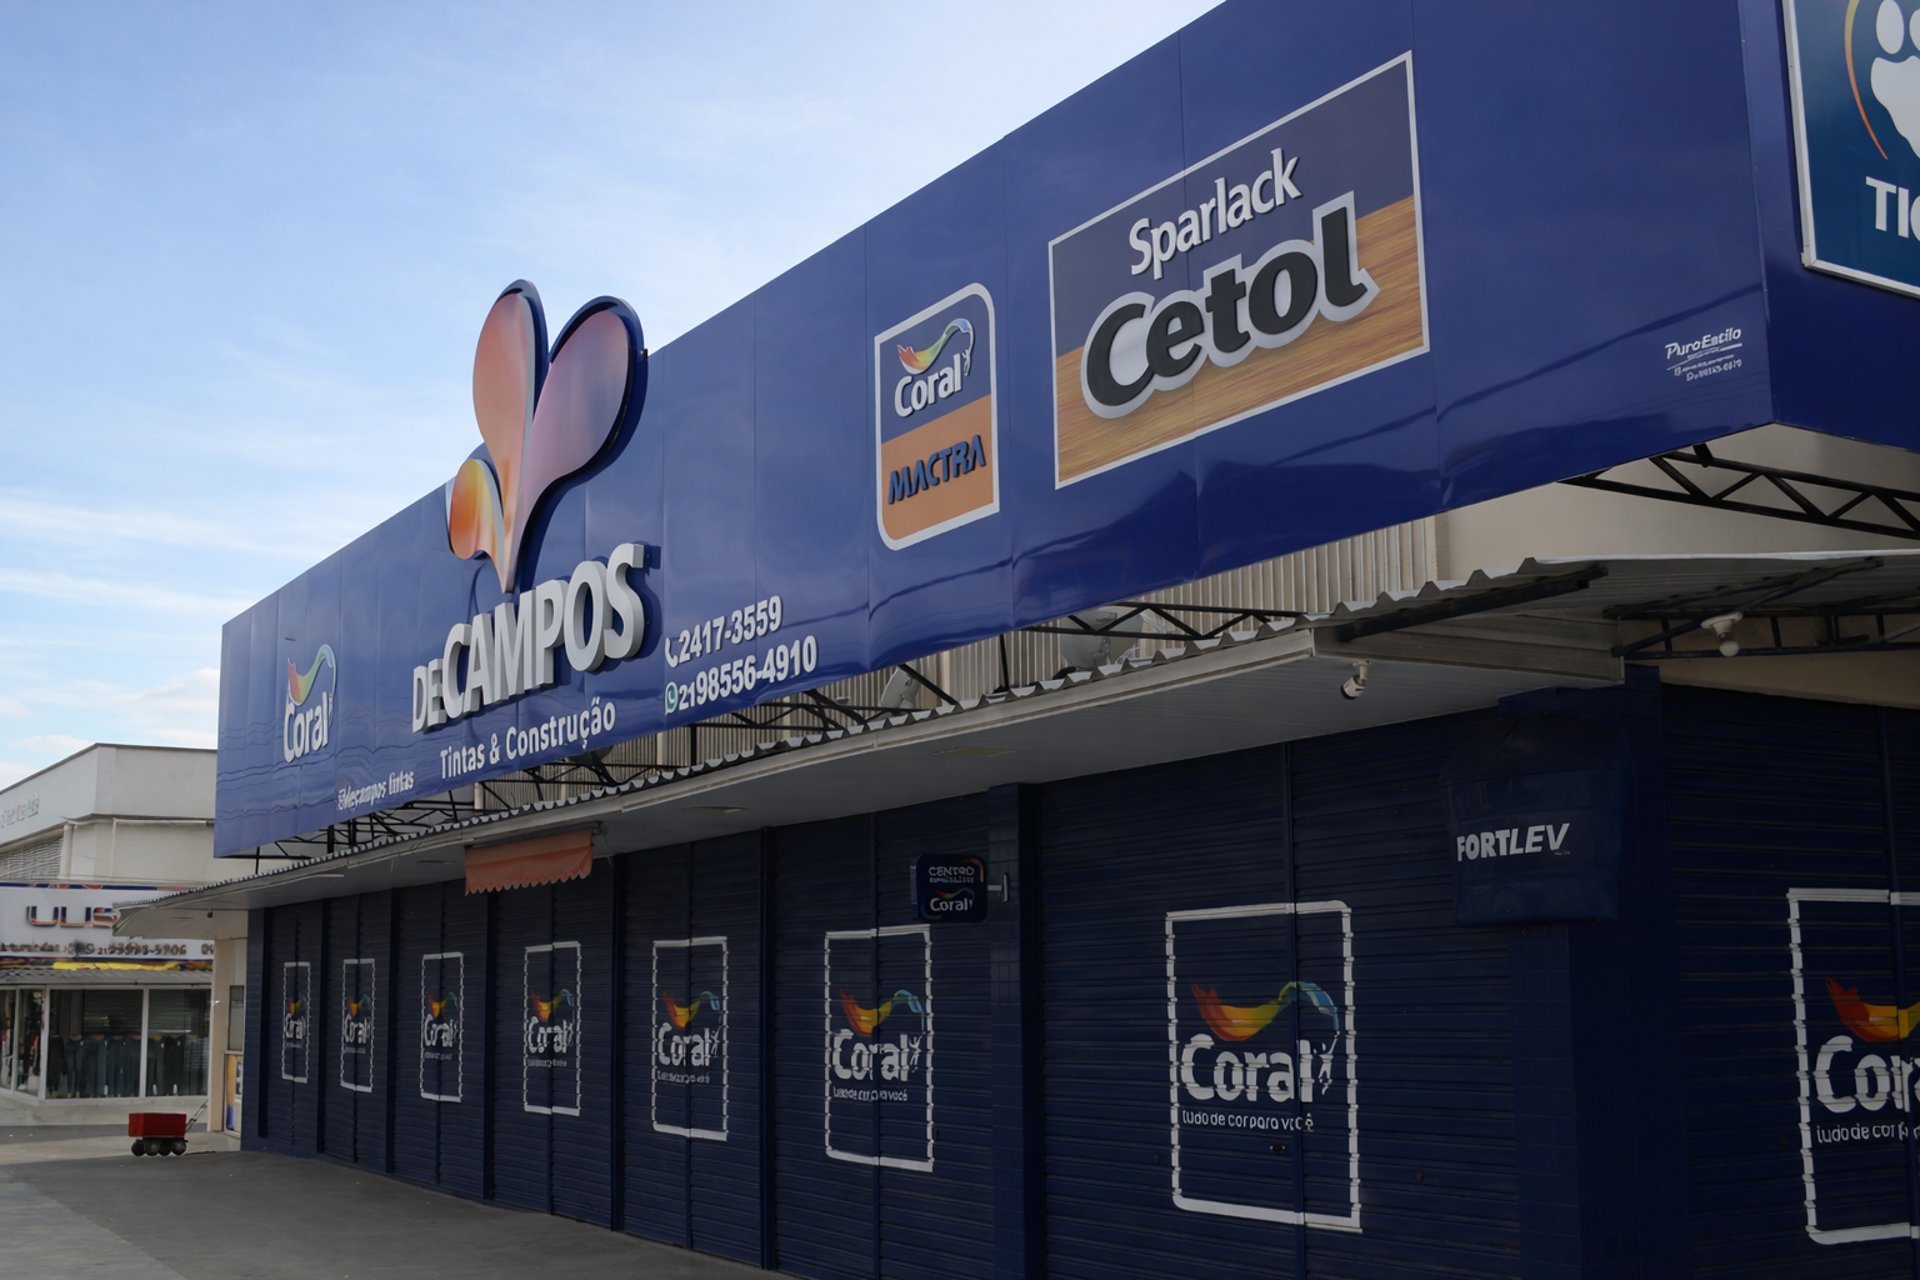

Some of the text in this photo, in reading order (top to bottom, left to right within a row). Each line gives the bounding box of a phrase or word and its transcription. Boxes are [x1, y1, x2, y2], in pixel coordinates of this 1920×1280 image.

[1129, 148, 1302, 280] Sparlack
[1083, 195, 1373, 412] Cetol
[895, 353, 962, 417] Coral
[888, 435, 986, 504] MACTRA
[679, 595, 782, 664] 2417-3559
[284, 691, 329, 763] Coral
[440, 697, 616, 779] Tintas & Construção
[1456, 822, 1571, 862] FORTLEV
[930, 897, 968, 912] Coral
[658, 1022, 710, 1067] Coral
[832, 1028, 908, 1082] Coral
[1180, 1033, 1314, 1103] Coral
[1812, 1034, 1920, 1113] Cor
[1227, 1114, 1249, 1128] cor
[1850, 1122, 1870, 1140] de
[1872, 1124, 1895, 1139] cor
